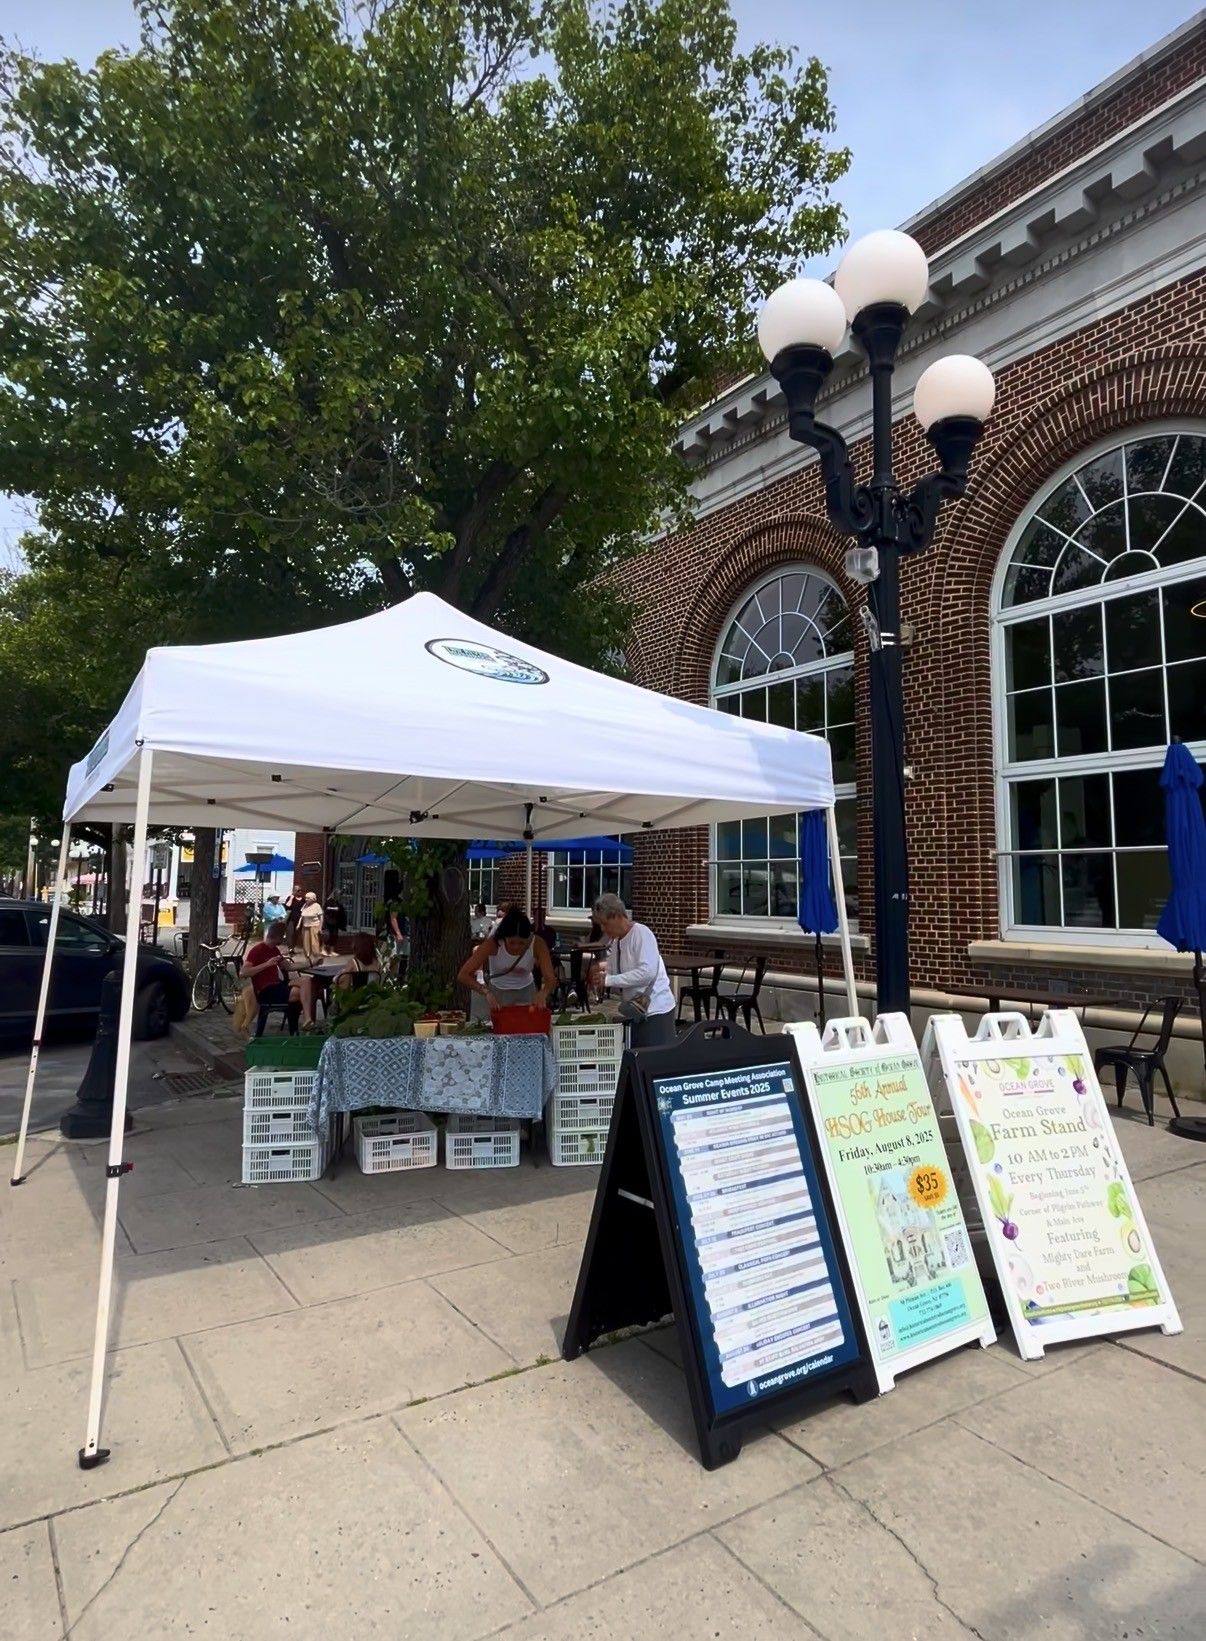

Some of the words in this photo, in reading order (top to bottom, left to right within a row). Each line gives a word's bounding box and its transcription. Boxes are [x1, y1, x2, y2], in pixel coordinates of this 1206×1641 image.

[659, 1085, 682, 1094] Ocean
[683, 1081, 704, 1090] Grove
[705, 1077, 725, 1088] Camp
[725, 1074, 751, 1086] Meeting
[751, 1069, 786, 1080] Association
[850, 1081, 872, 1105] 56th
[875, 1074, 908, 1100] Annual
[999, 1080, 1027, 1091] OCEAN
[1028, 1079, 1055, 1090] GROVE
[682, 1091, 719, 1105] Summer
[721, 1087, 750, 1099] Events
[750, 1082, 771, 1094] 2025
[825, 1111, 872, 1139] HSOG
[873, 1108, 906, 1128] House
[906, 1101, 931, 1125] Tour
[1003, 1108, 1034, 1119] Ocean
[1036, 1105, 1067, 1117] Grove
[990, 1123, 1038, 1141] Farm
[1040, 1116, 1087, 1135] Stand
[839, 1147, 874, 1161] Friday,
[875, 1138, 905, 1154] August
[915, 1130, 935, 1145] 2025
[1008, 1153, 1023, 1165] 10
[1028, 1149, 1048, 1163] AM
[1049, 1150, 1060, 1160] to
[1061, 1148, 1070, 1159] 2
[1070, 1145, 1089, 1158] PM
[864, 1162, 893, 1176] 10:30am
[898, 1155, 921, 1167] 4:30pm
[1009, 1172, 1043, 1184] Every
[1046, 1165, 1096, 1180] Thursday
[916, 1172, 938, 1195] $35
[1046, 1229, 1101, 1245] Featuring
[1041, 1251, 1072, 1265] Mighty
[1093, 1245, 1115, 1256] Farm
[1076, 1262, 1091, 1272] and
[1043, 1280, 1061, 1291] Two
[1061, 1277, 1084, 1288] River
[759, 1354, 834, 1390] oceangrove.org/calendar
